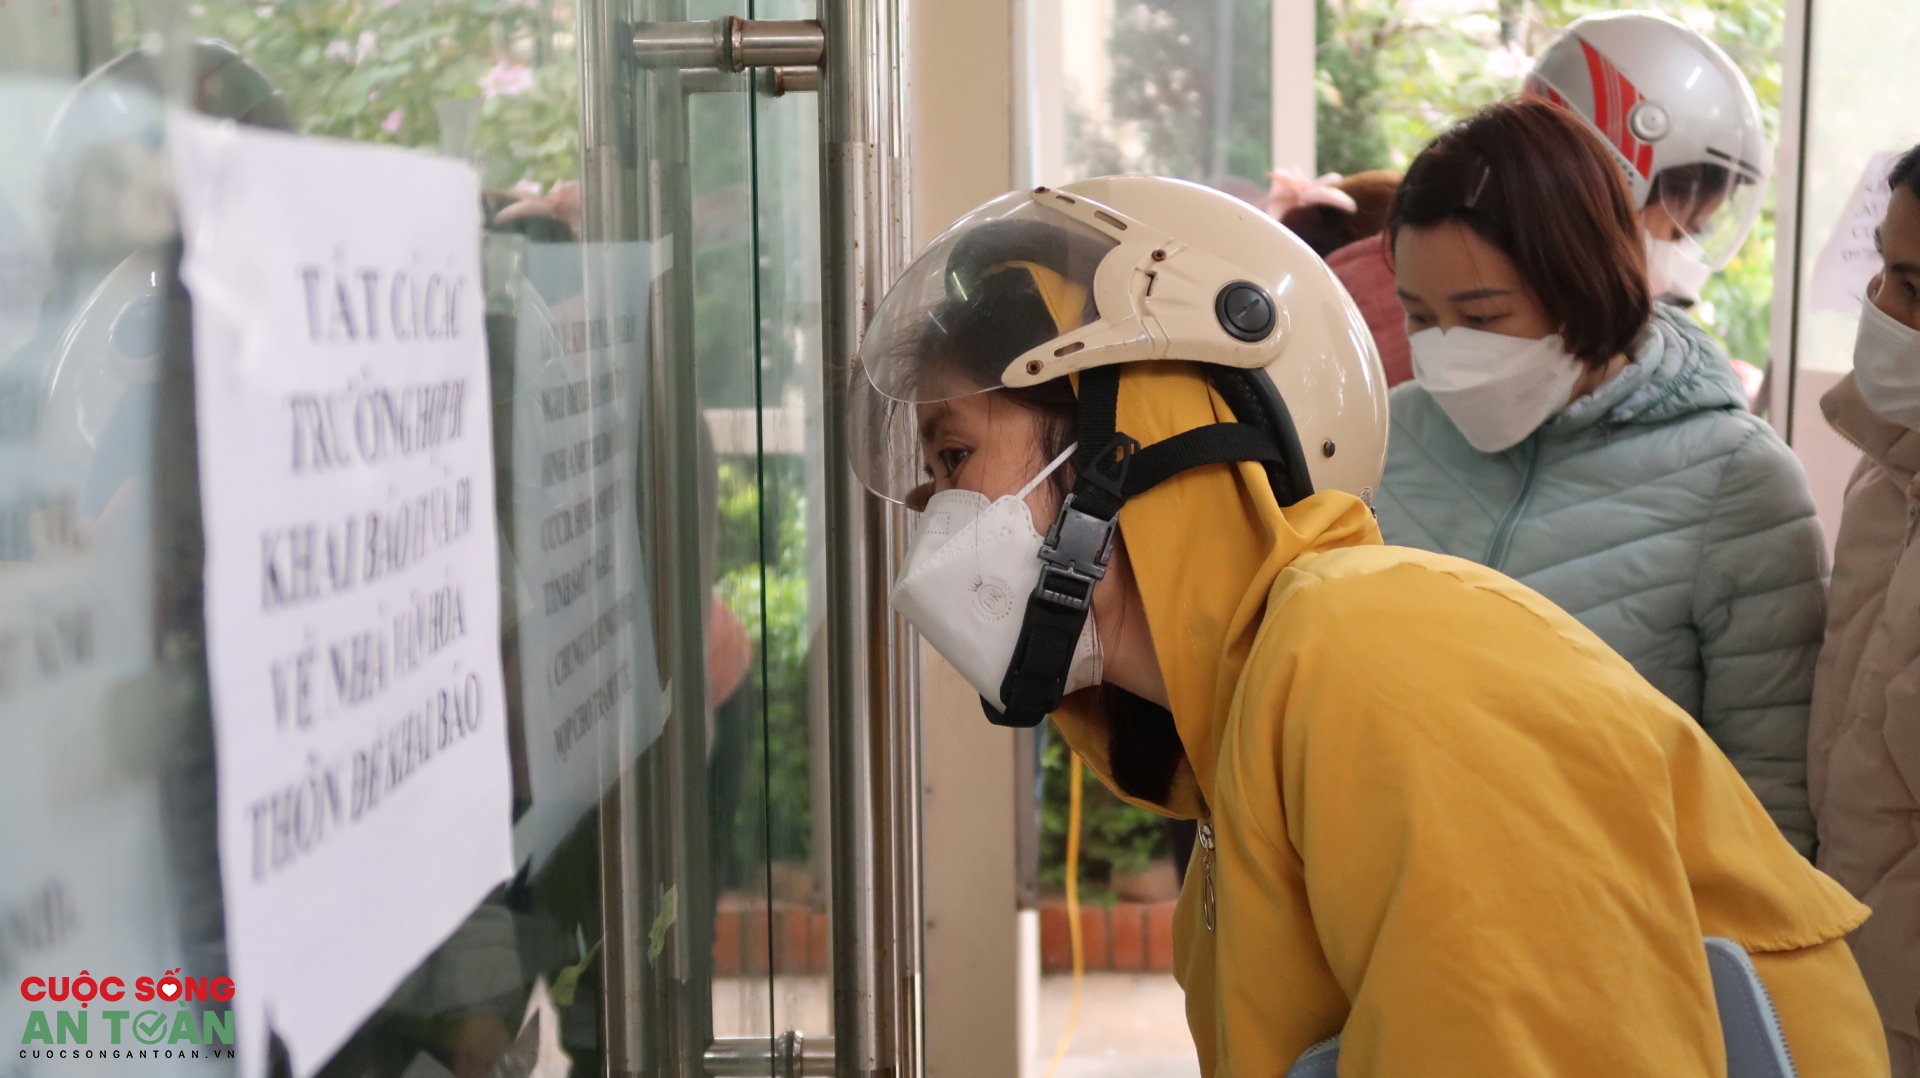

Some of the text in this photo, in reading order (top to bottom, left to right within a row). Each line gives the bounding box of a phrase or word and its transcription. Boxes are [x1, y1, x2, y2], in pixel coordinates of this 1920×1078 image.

[300, 246, 378, 342] TẤT
[251, 752, 341, 882] THÔN
[436, 660, 484, 750] BÁO
